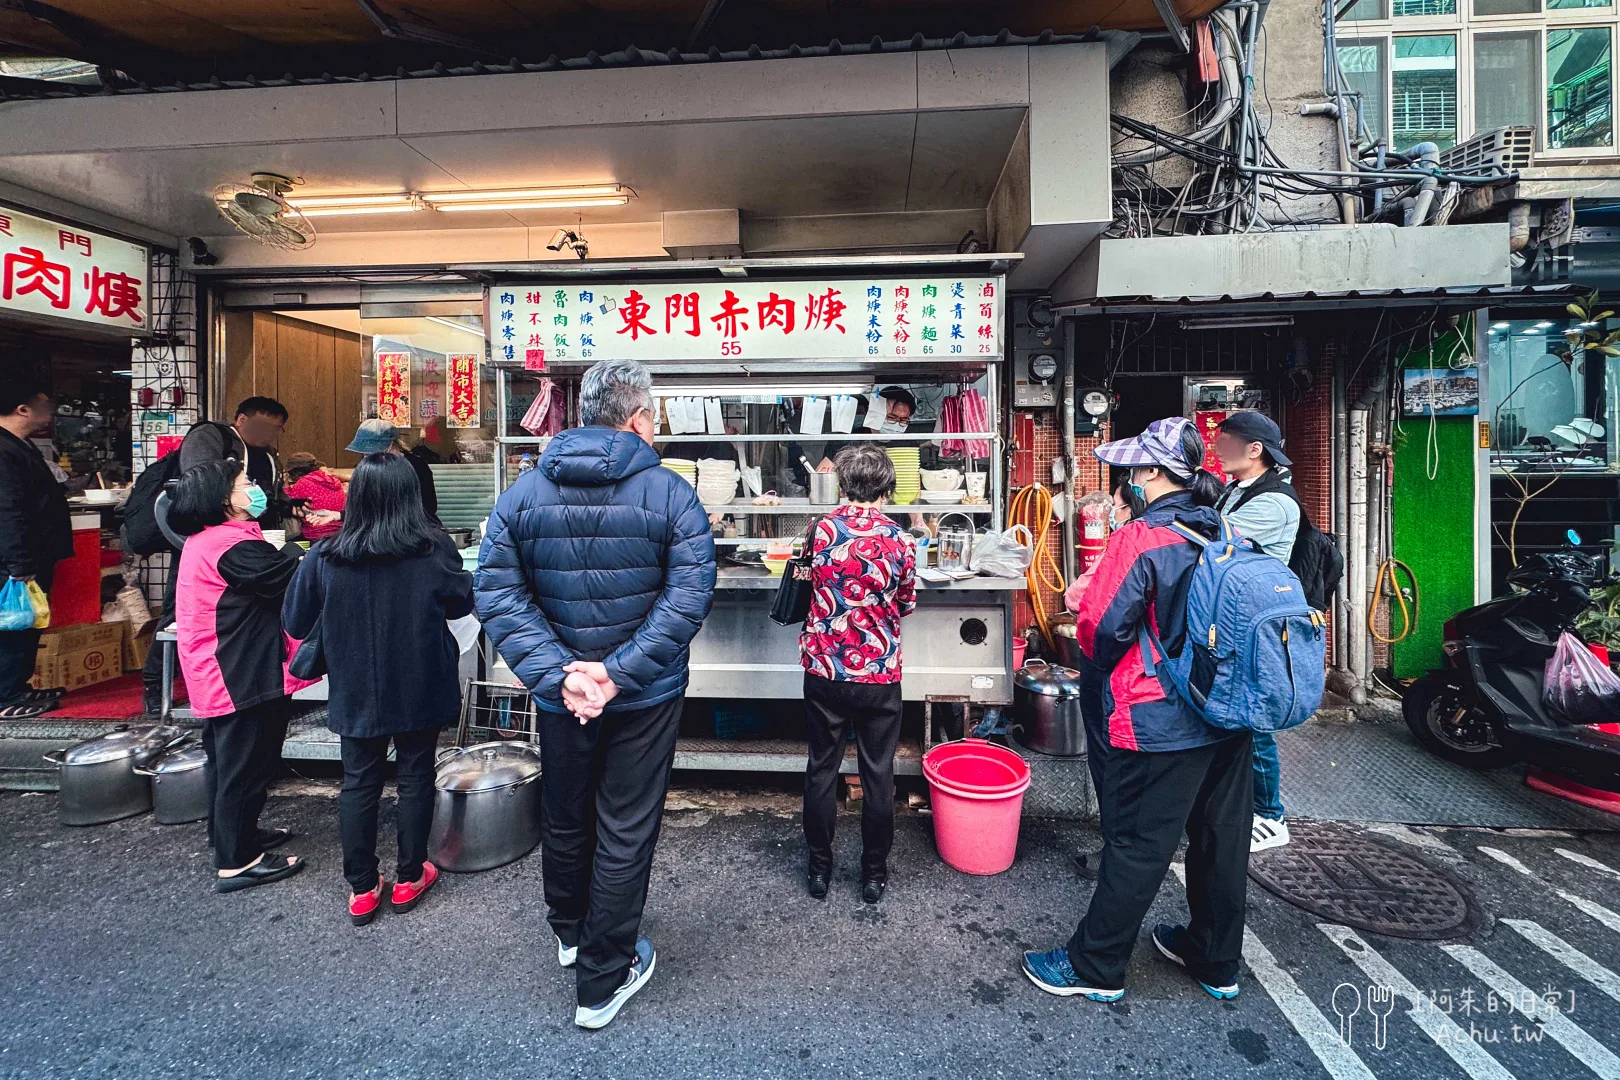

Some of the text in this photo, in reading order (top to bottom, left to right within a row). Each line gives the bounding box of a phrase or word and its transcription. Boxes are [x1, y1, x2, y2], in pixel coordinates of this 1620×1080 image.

[3, 246, 142, 322] 肉焿
[950, 281, 966, 340] 燙青菜
[978, 282, 994, 339] 滷筍絲
[500, 292, 516, 360] 肉焿零售
[525, 291, 544, 347] 甜不辣
[553, 290, 570, 347] 魯肉飯
[579, 290, 596, 347] 肉焿飯
[616, 287, 847, 341] 東門赤肉焿
[865, 285, 883, 343] 肉焿米粉
[893, 285, 911, 343] 肉焿冬粉
[921, 284, 938, 342] 肉焿麵
[556, 348, 566, 358] 35
[582, 348, 592, 358] 65
[721, 341, 742, 356] 55
[868, 345, 879, 355] 65
[896, 346, 906, 355] 65
[923, 345, 933, 354] 65
[950, 344, 962, 353] 30
[979, 344, 991, 353] 25
[146, 421, 162, 433] 56
